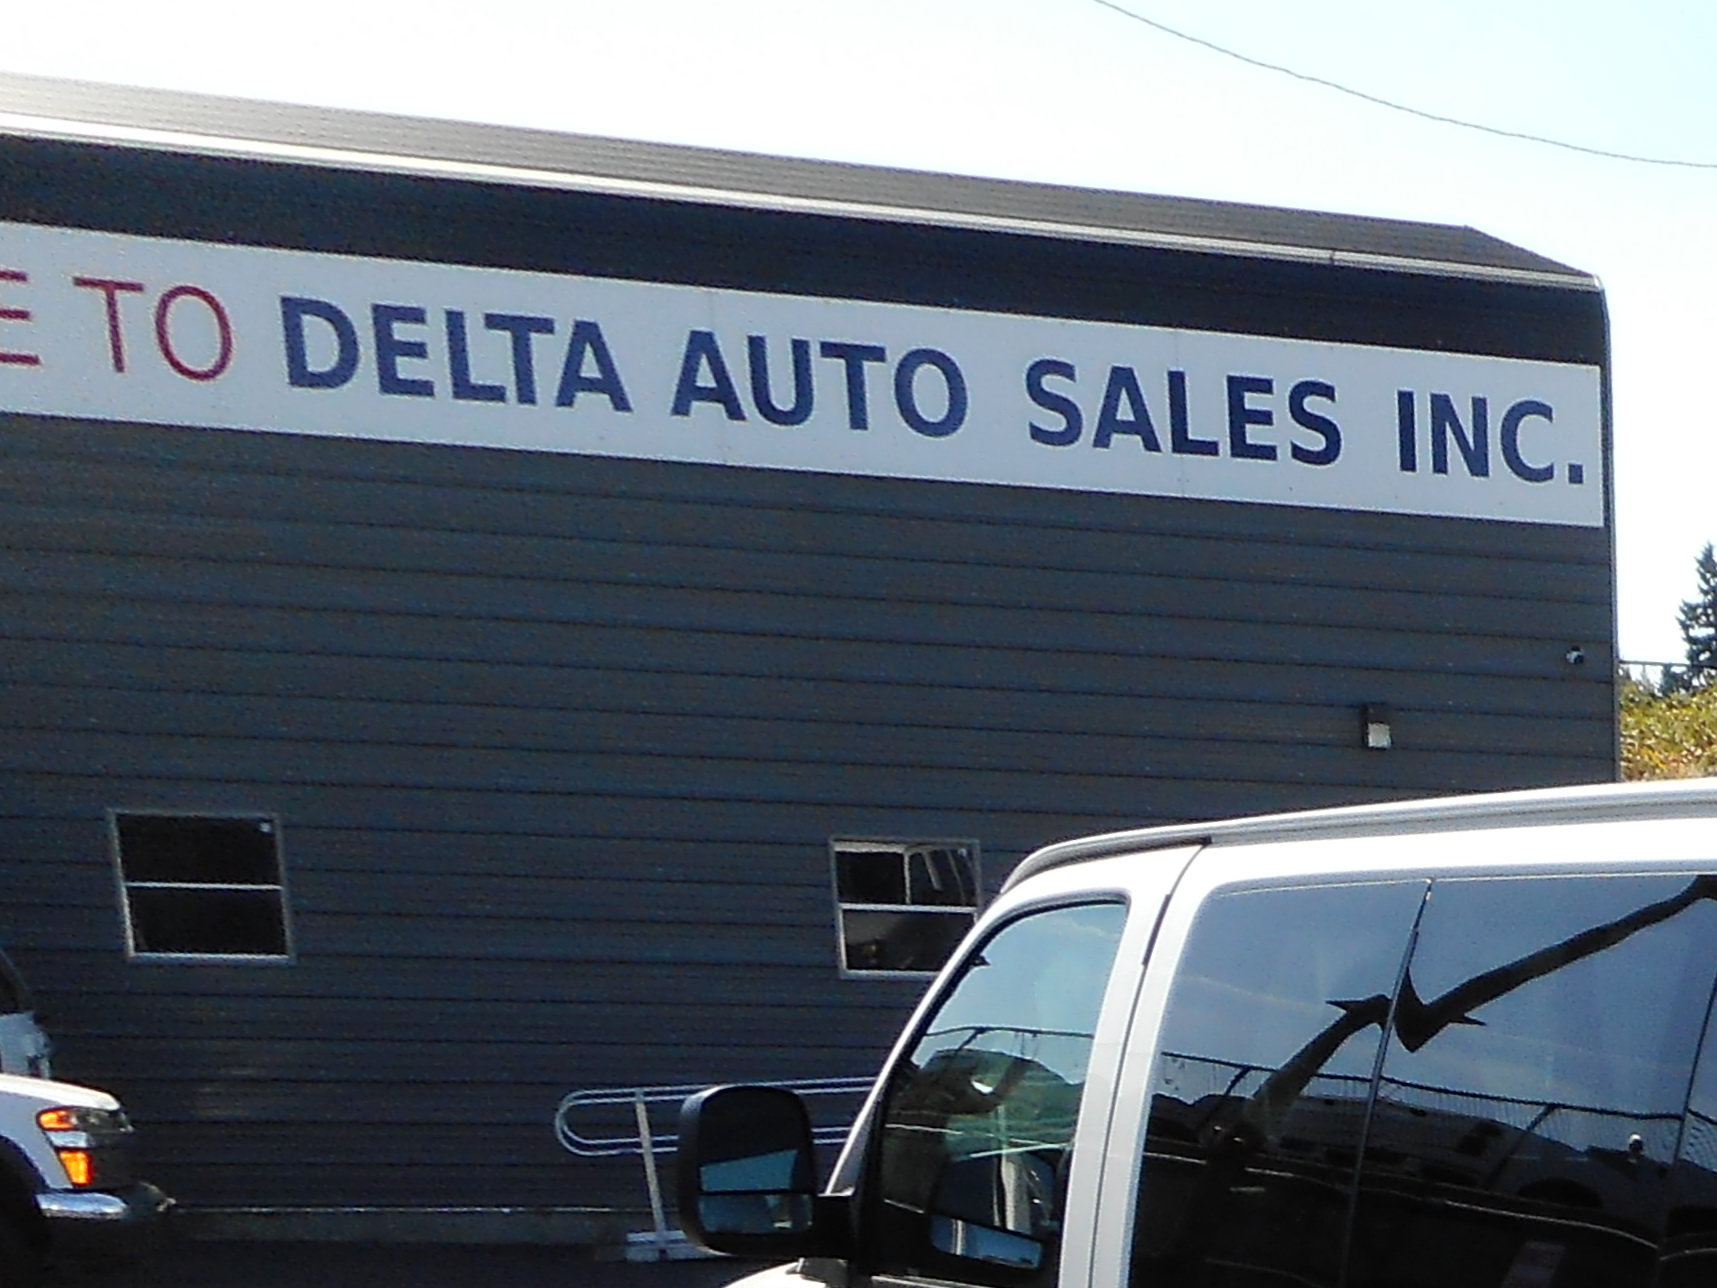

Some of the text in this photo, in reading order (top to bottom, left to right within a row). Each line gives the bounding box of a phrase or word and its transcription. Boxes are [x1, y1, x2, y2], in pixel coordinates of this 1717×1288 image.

[72, 275, 234, 382] TO
[279, 295, 634, 414] DELTA
[671, 329, 969, 439] AUTO
[1024, 357, 1343, 467] SALES
[1396, 389, 1585, 485] INC.
